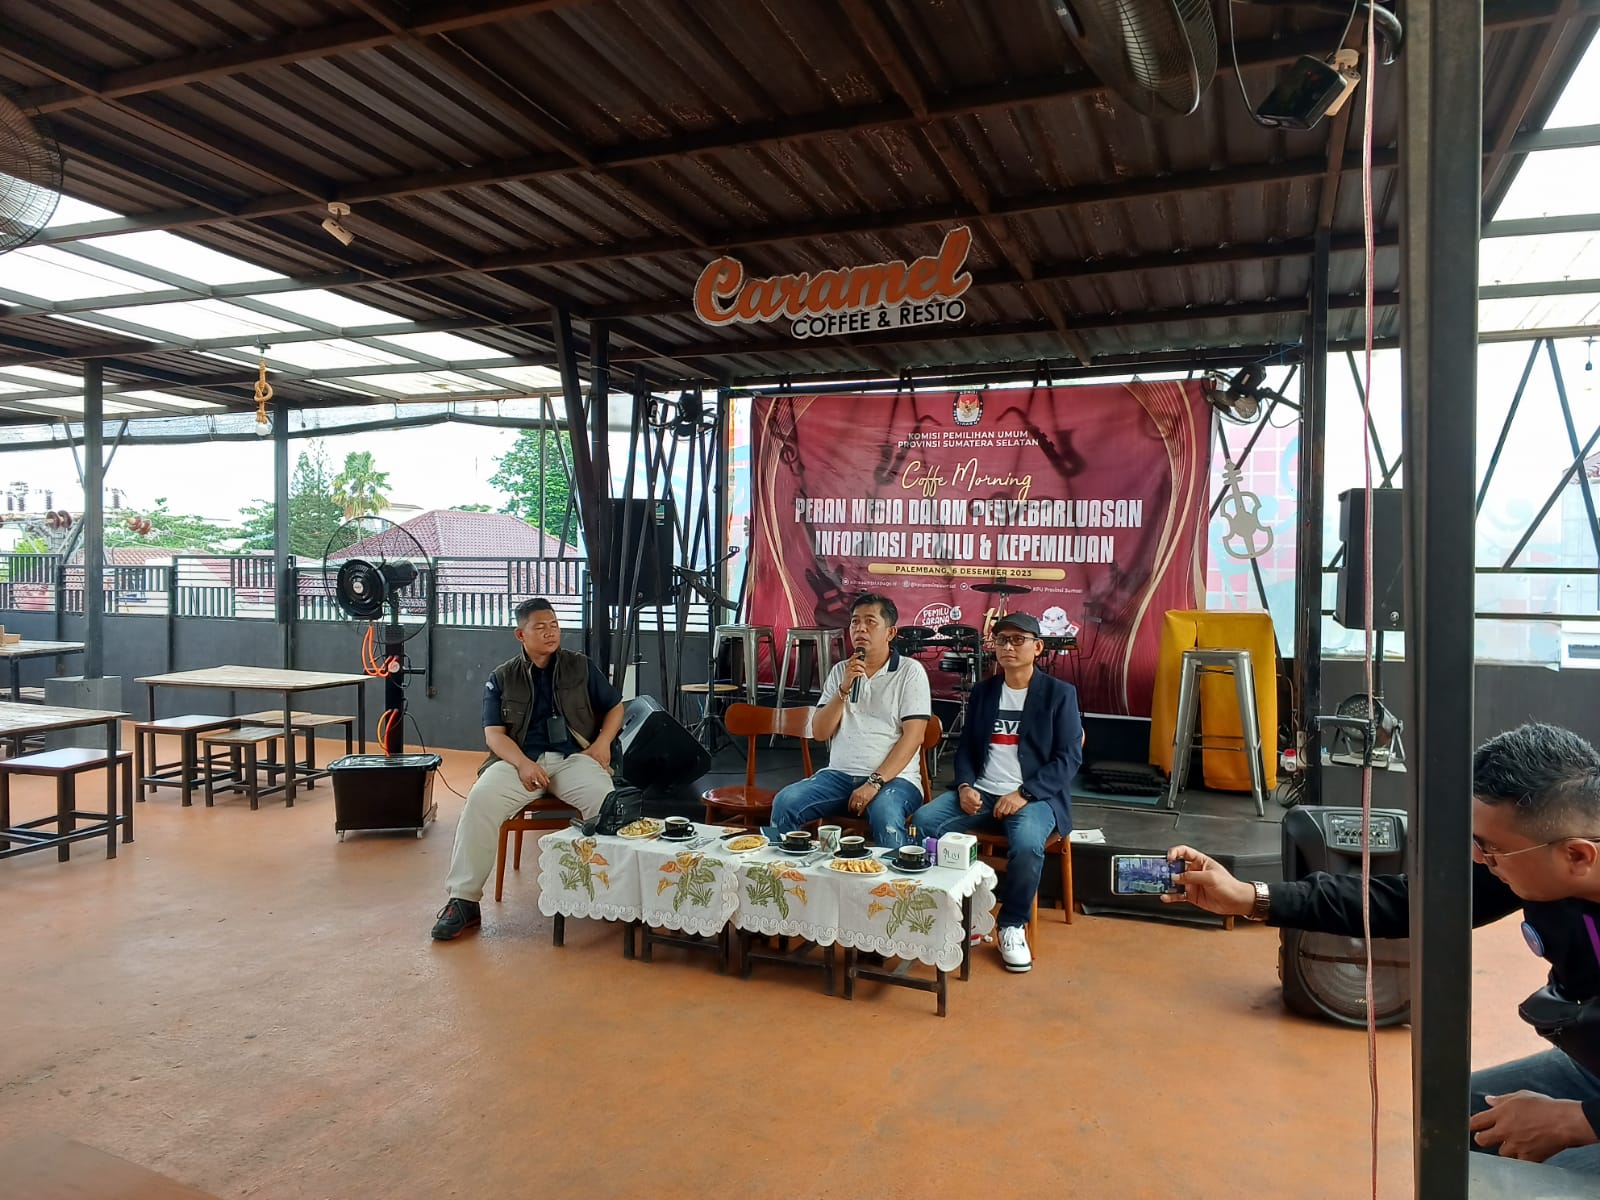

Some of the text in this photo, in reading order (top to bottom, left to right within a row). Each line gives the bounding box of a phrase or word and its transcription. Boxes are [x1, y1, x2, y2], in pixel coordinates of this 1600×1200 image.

[694, 225, 973, 325] Caramel
[793, 300, 964, 336] COFFEE & RESTO
[898, 439, 1039, 448] PROVINSI SUMATERA SELATAN
[908, 431, 1028, 440] KOMISI PEMILIHAN UMUM
[902, 457, 1032, 500] Coffe Morning
[794, 497, 1142, 528] PERAN MEDIA DALAM PENYEBARLUASAN
[815, 530, 1115, 563] INFORMASI PEMILU & KEPEMILUAN
[895, 565, 950, 574] PALEMBANG,
[960, 567, 1007, 576] DESEMBER
[1010, 569, 1032, 577] 2023
[922, 615, 950, 626] SARANA
[923, 607, 949, 618] PEMILU
